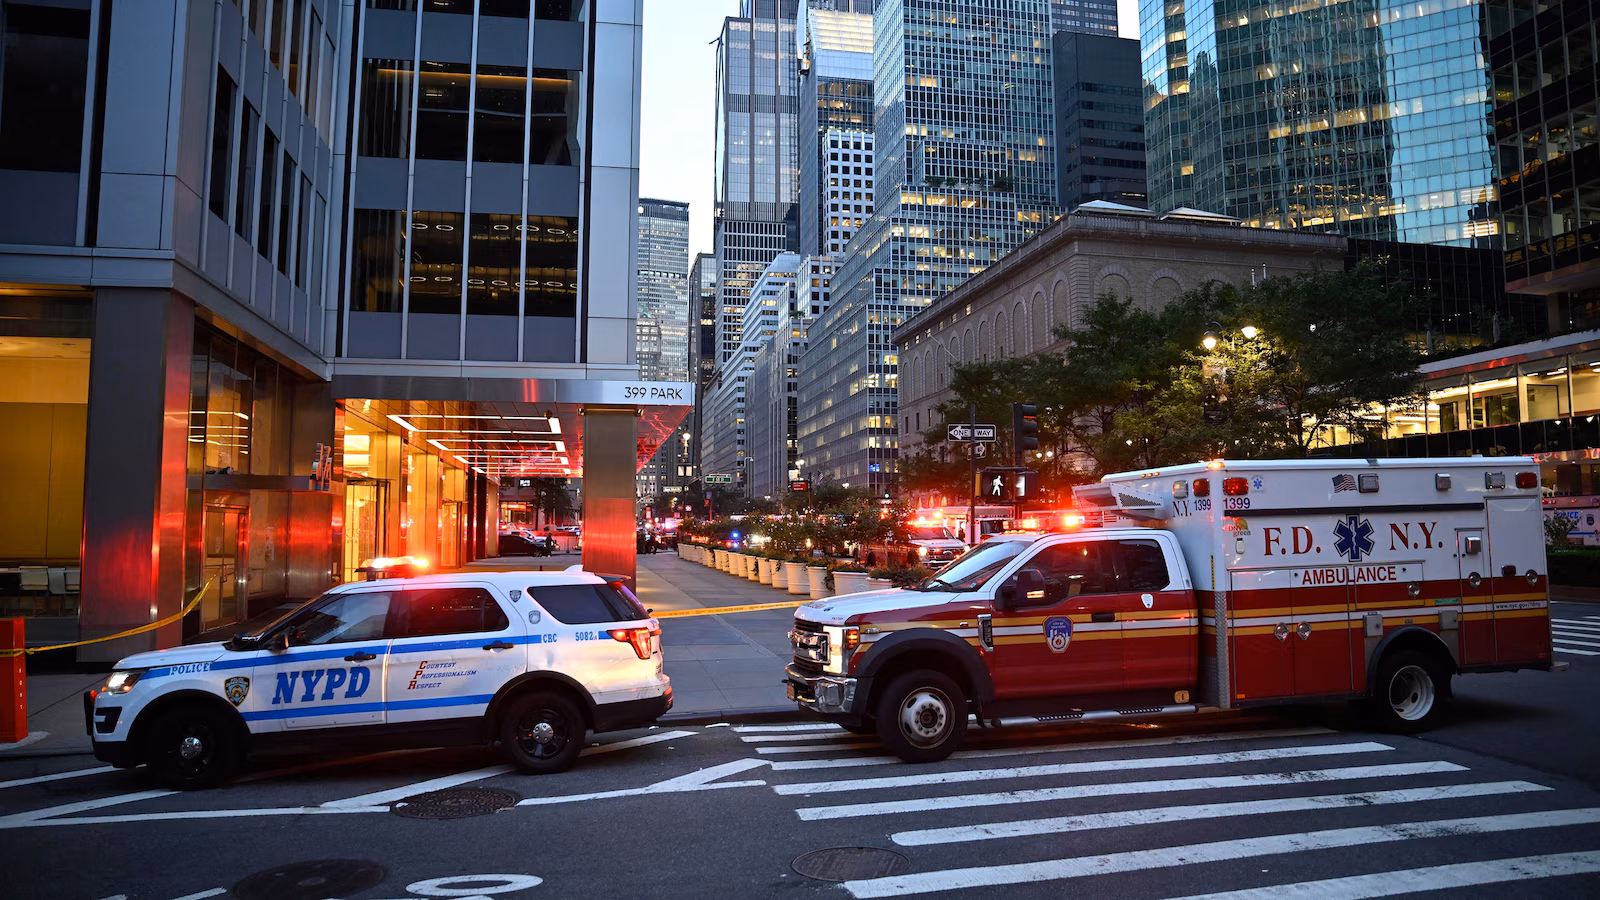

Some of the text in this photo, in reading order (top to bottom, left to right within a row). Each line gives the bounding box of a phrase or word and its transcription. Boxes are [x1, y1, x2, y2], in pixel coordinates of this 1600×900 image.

[624, 386, 683, 400] 399 PARK
[953, 429, 969, 437] ONE
[1172, 500, 1192, 517] N.Y.
[1194, 498, 1211, 511] 1399
[1223, 497, 1251, 509] 1399
[1263, 522, 1443, 556] F.D. N.Y.
[1302, 566, 1397, 585] AMBULANCE
[543, 633, 557, 643] CRC
[170, 662, 211, 676] POLICE
[419, 660, 457, 669] COURTESY
[413, 670, 477, 679] PROFESSIONALISM
[272, 666, 371, 705] NYPD
[407, 680, 442, 690] RESPECT
